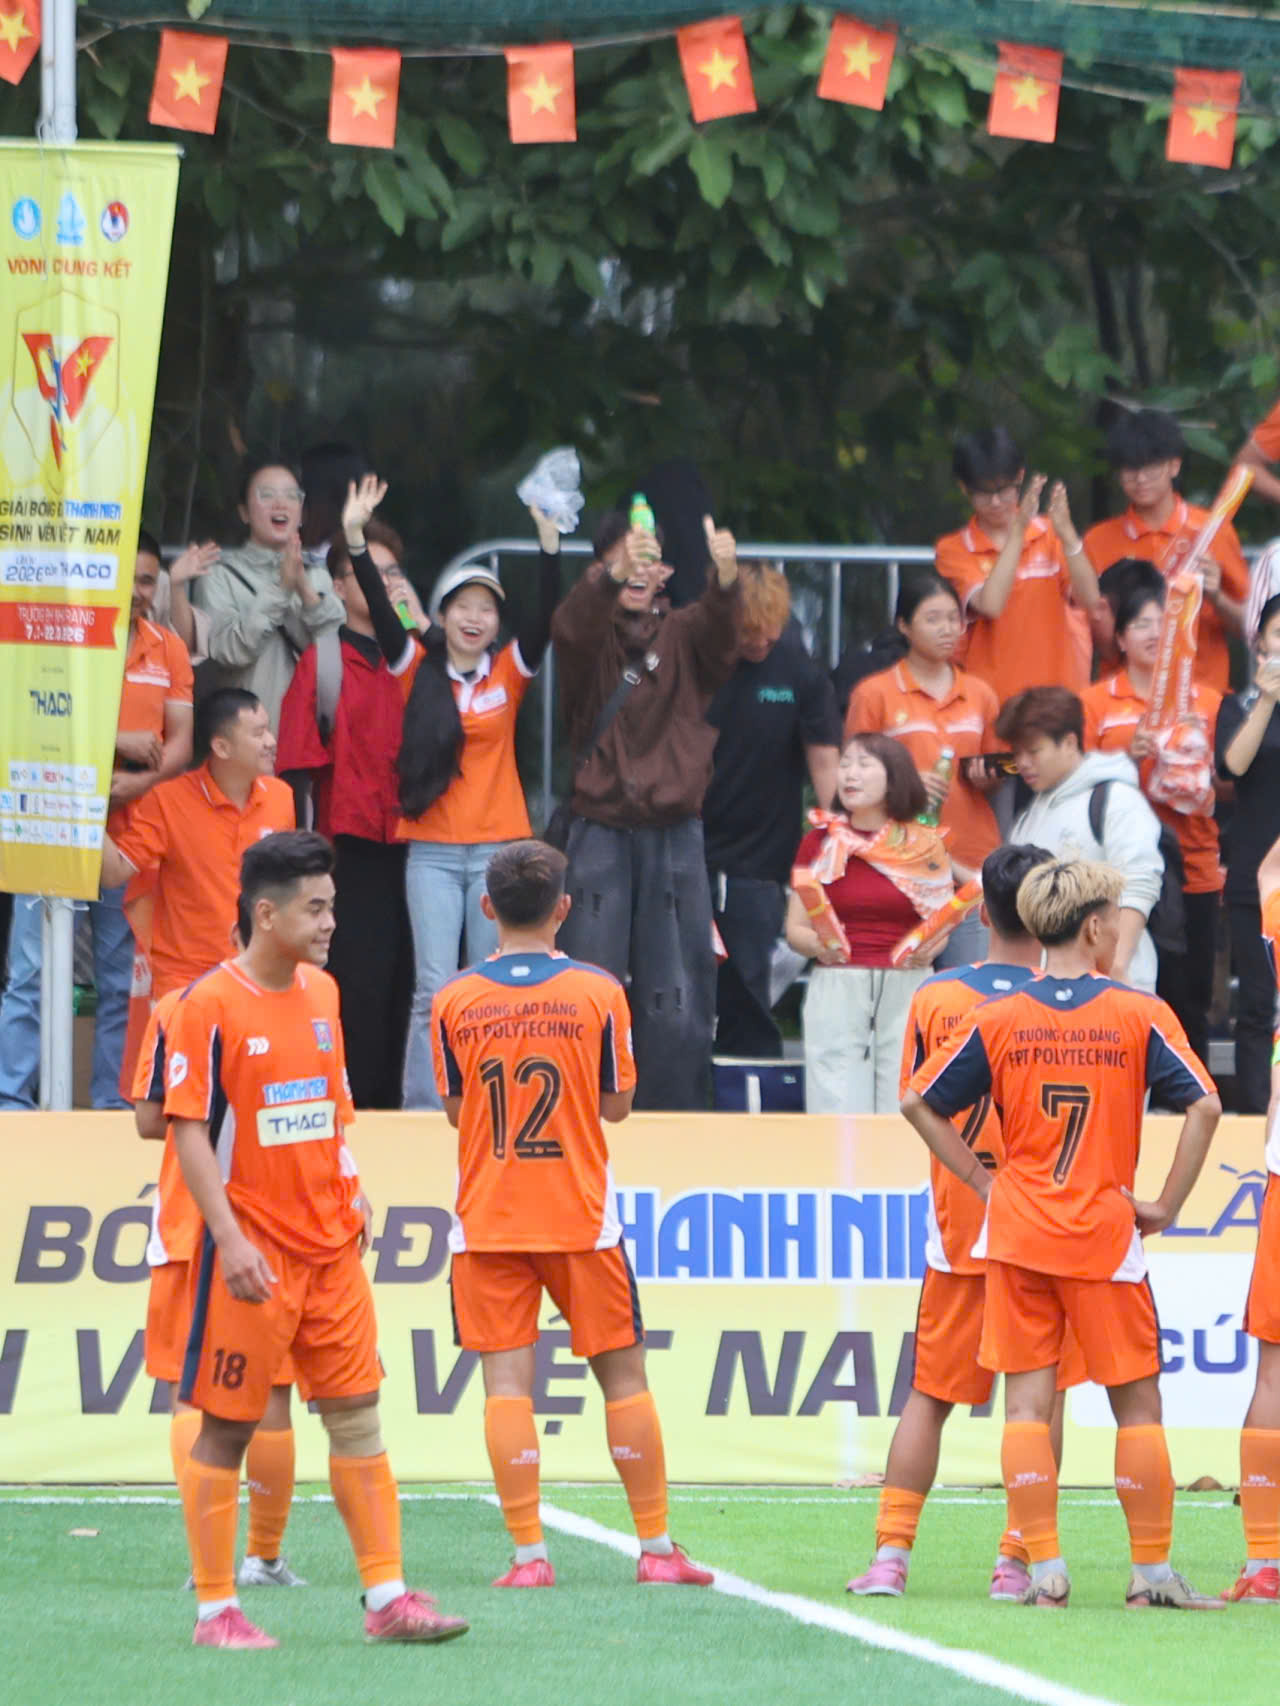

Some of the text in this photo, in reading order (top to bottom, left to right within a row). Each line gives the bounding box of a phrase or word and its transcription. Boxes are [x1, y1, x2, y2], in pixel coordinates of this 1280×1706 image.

[85, 527, 121, 547] NAM
[514, 1002, 539, 1016] CAO
[456, 1020, 584, 1046] FPT POLYTECHNIC
[1062, 1028, 1086, 1043] CAO
[1008, 1046, 1128, 1070] FPT POLYTECHNIC
[479, 1056, 563, 1160] 12
[1041, 1083, 1092, 1185] 7
[211, 1347, 248, 1390] 18
